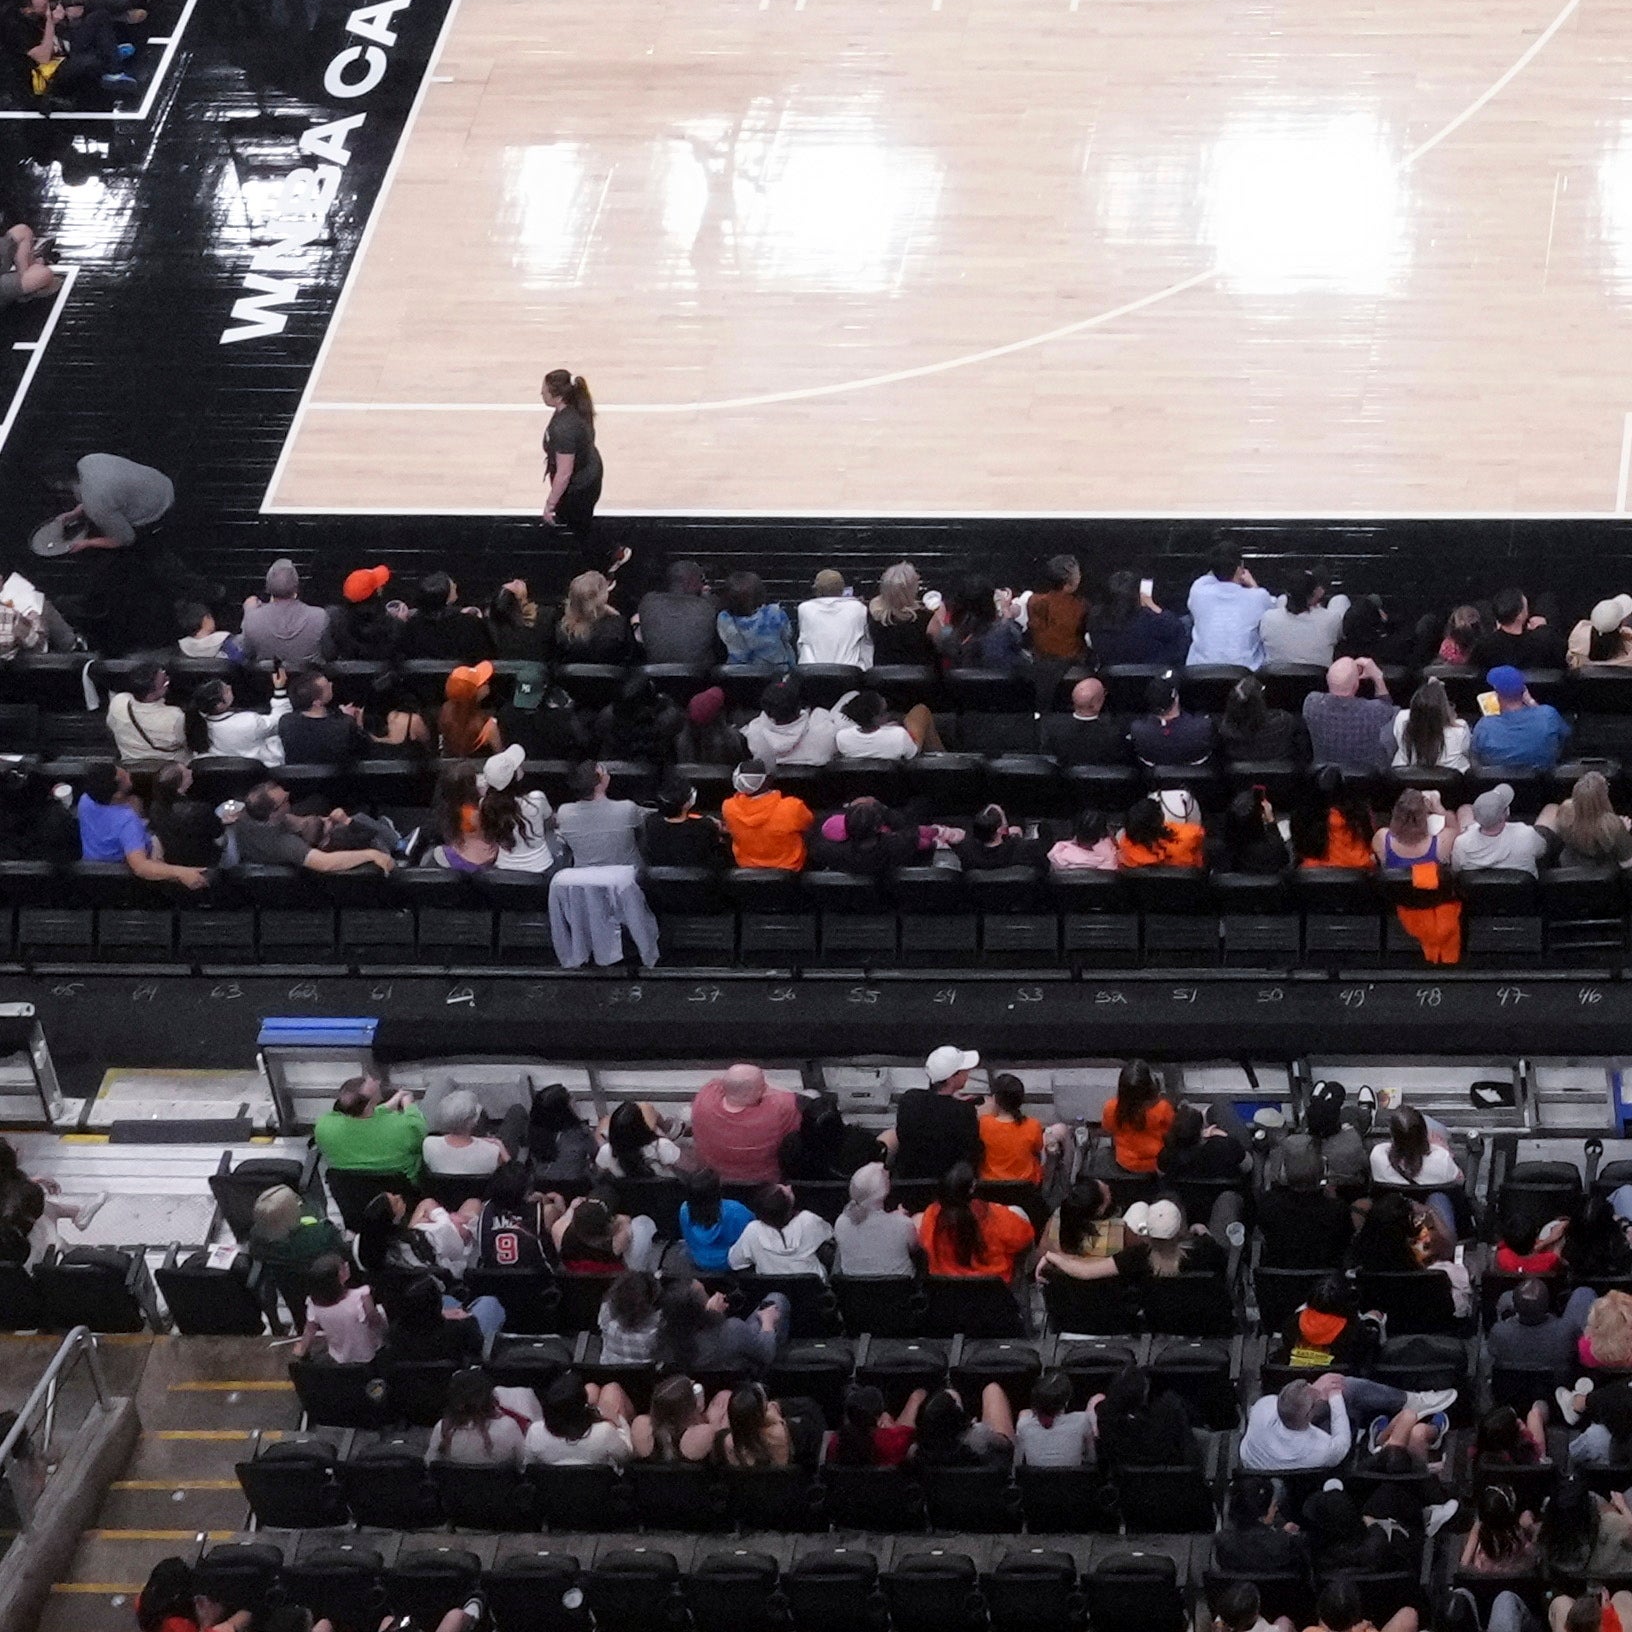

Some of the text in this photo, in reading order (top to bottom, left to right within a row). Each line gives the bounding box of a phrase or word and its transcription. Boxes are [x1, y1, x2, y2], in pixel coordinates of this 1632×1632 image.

[221, 112, 367, 344] WNBA
[210, 983, 245, 1000] 63
[370, 985, 393, 1001] 61
[1415, 988, 1443, 1005] 48
[1496, 988, 1531, 1005] 47
[1577, 987, 1604, 1004] 46
[495, 1232, 520, 1265] 9
